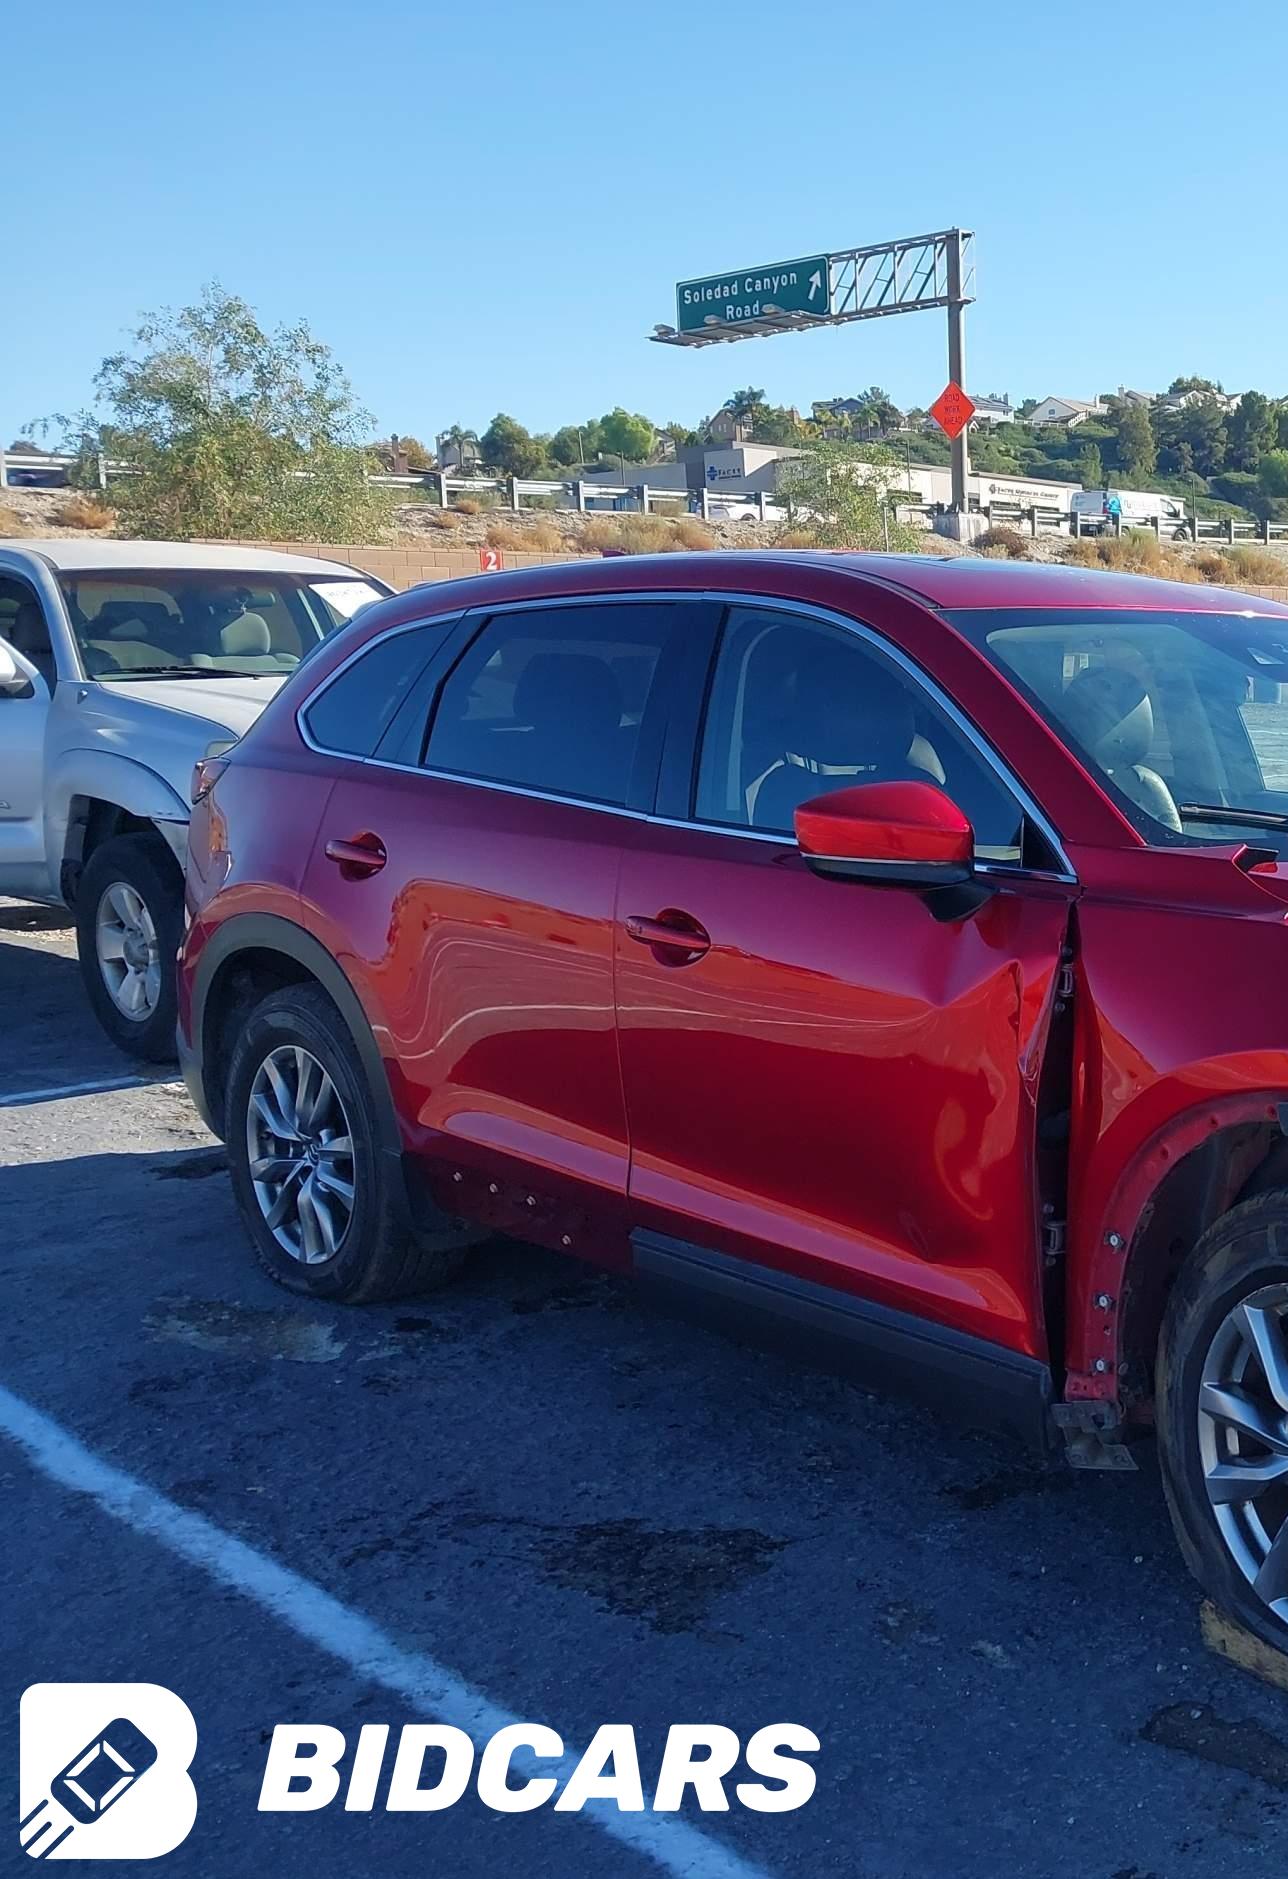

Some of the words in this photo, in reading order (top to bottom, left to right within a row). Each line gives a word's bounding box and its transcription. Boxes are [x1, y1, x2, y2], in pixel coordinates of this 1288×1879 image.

[684, 283, 738, 304] Soledad
[744, 272, 797, 294] Canyon
[726, 300, 760, 320] Road
[486, 551, 497, 570] 2
